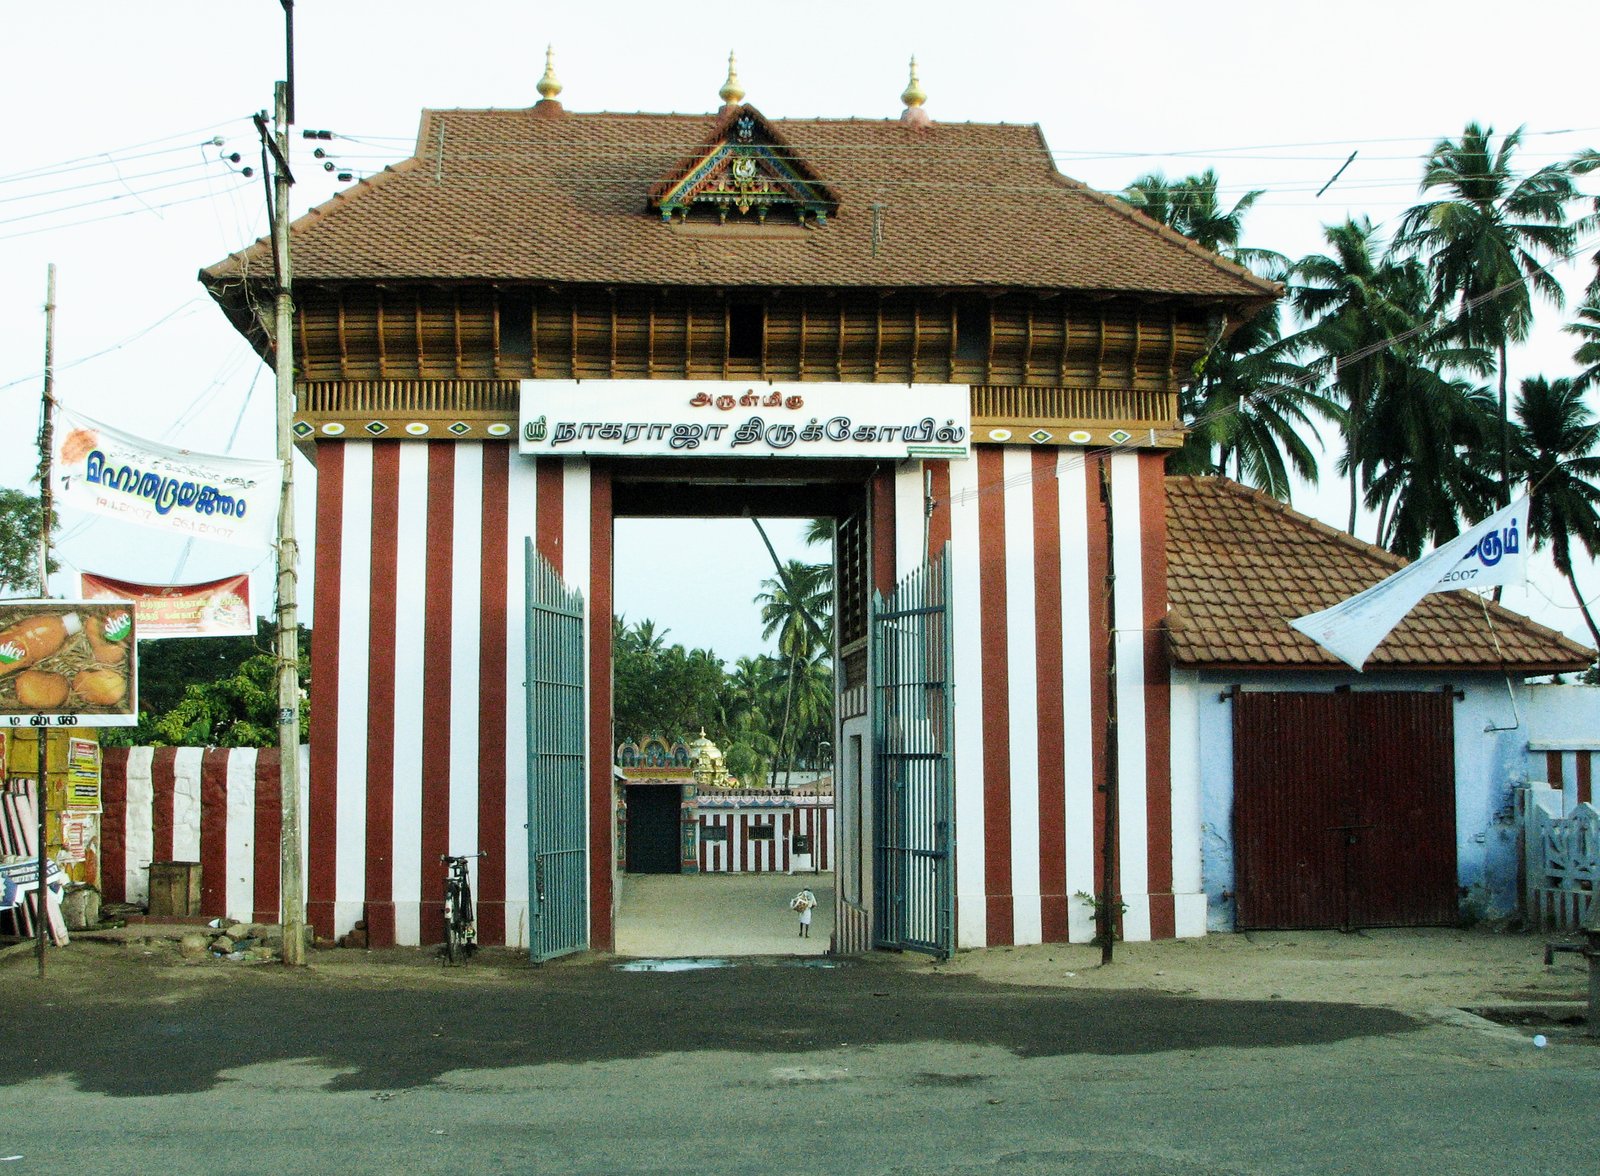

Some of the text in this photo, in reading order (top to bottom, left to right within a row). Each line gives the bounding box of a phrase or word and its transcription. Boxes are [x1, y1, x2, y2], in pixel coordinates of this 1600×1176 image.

[689, 389, 804, 410] அருள்மிகு
[551, 422, 729, 449] நாகராஜா
[731, 416, 965, 449] திருக்கோயில்
[104, 612, 130, 637] slice
